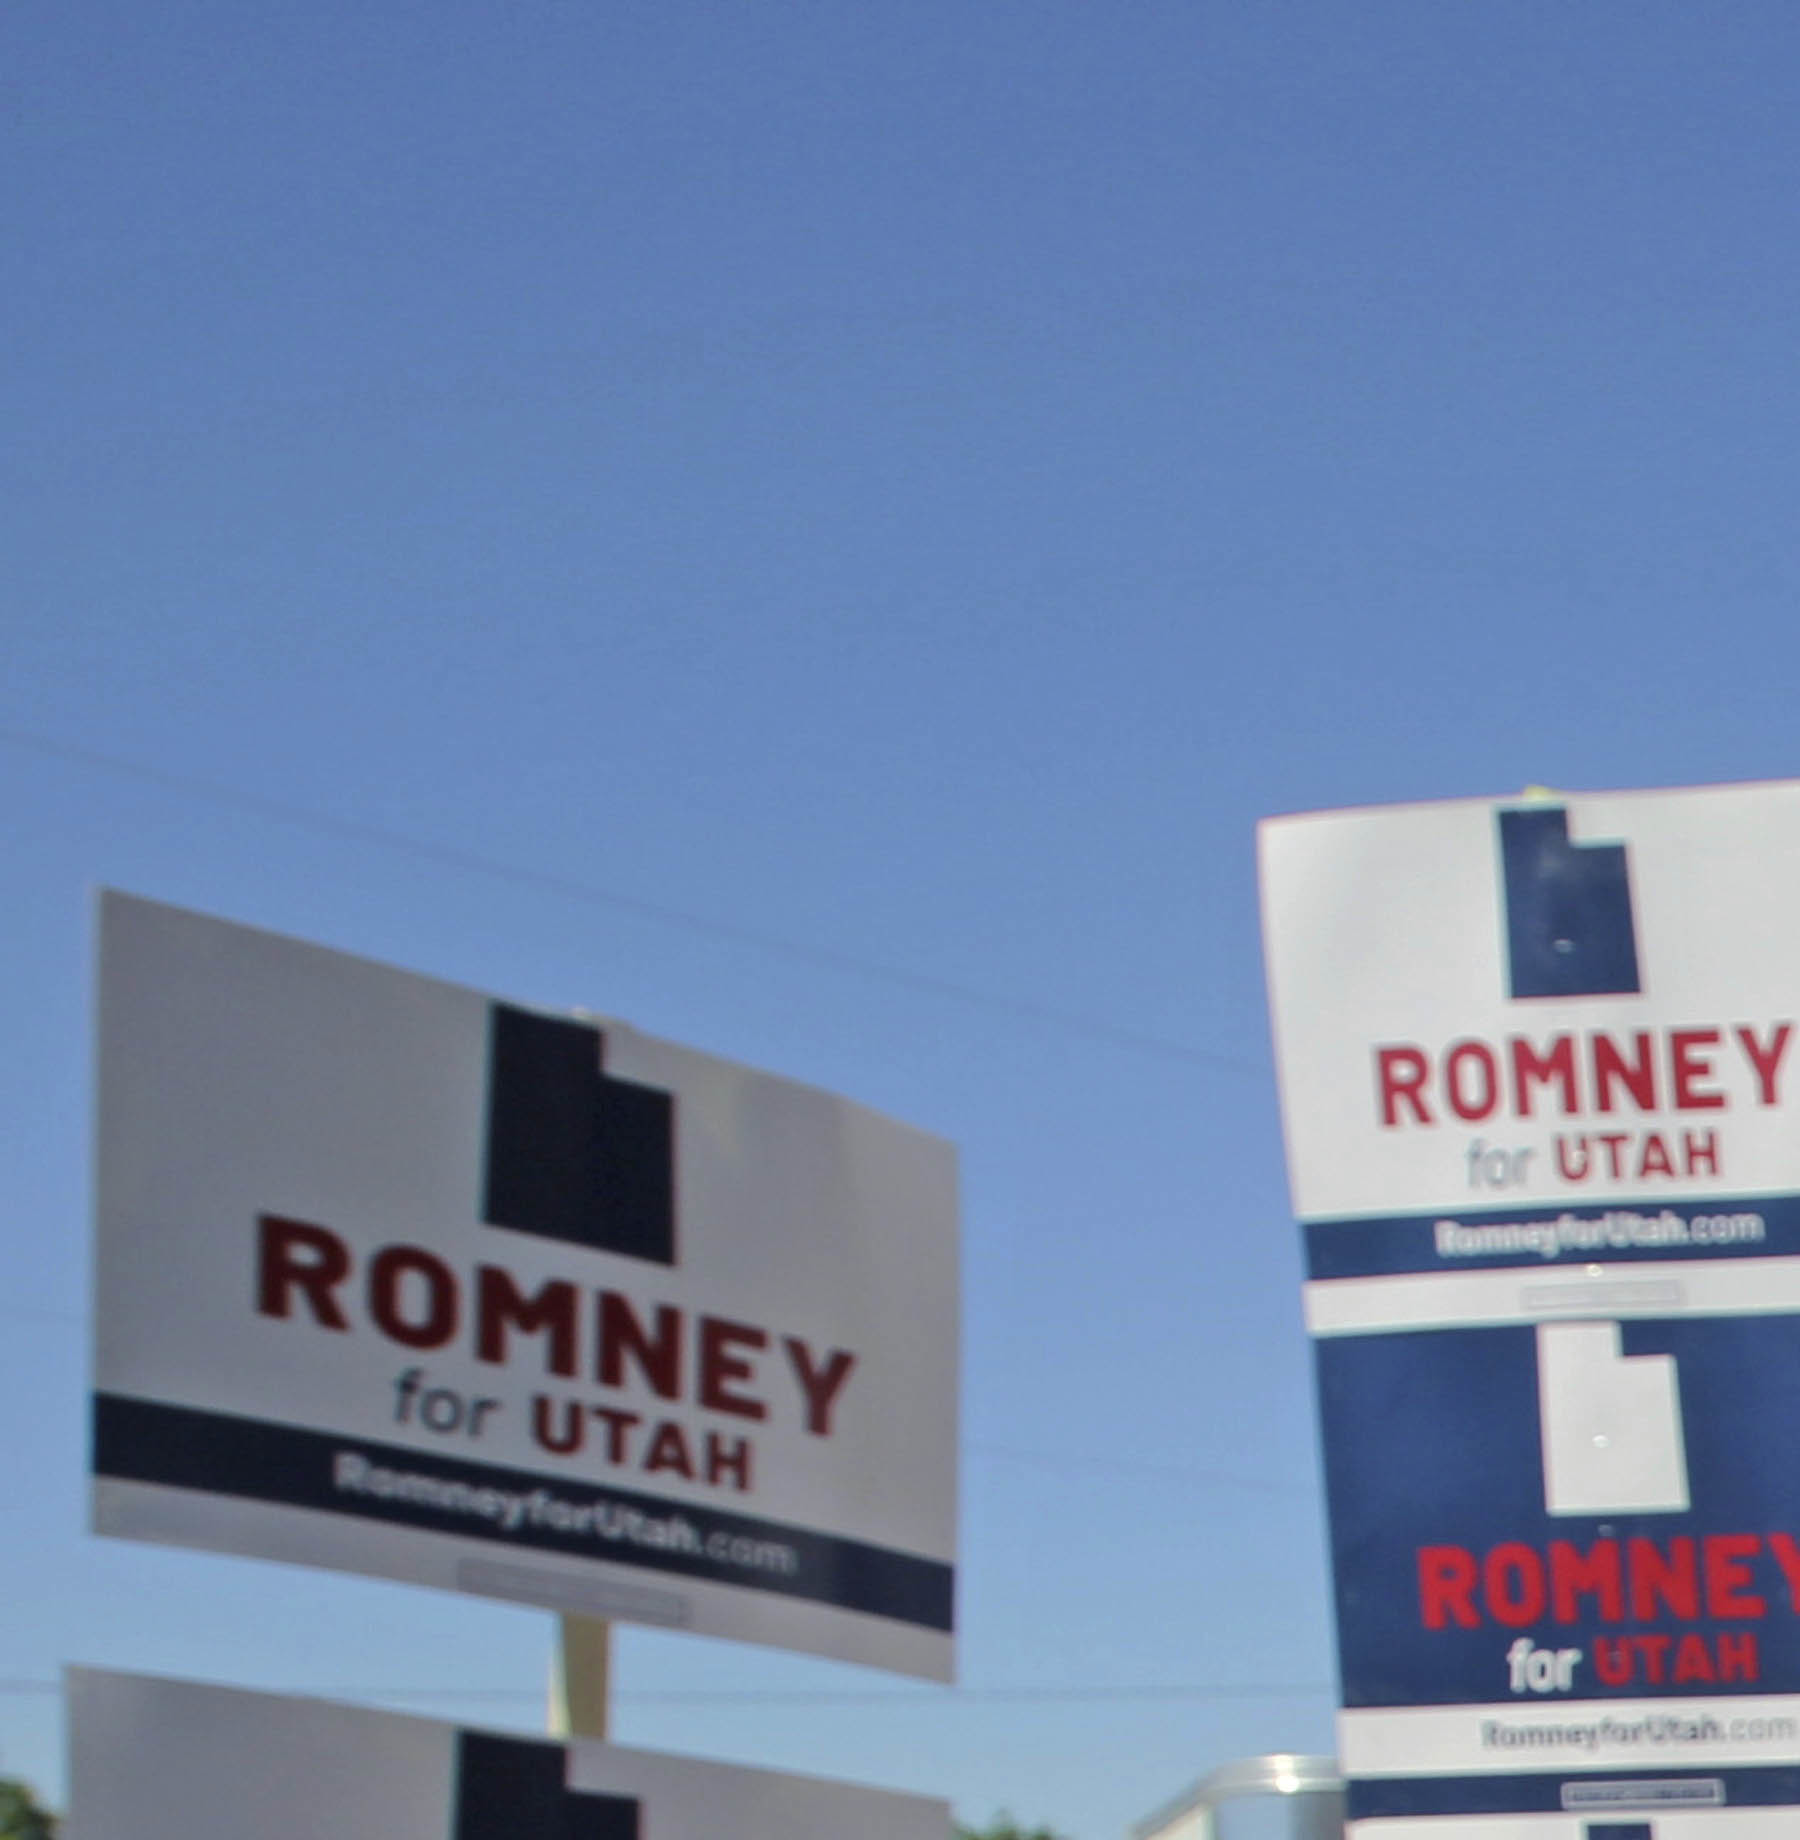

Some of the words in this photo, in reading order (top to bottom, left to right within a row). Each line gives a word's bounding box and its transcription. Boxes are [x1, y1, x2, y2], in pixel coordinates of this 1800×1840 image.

[1373, 1021, 1795, 1130] ROMNEY
[1465, 1139, 1533, 1189] for
[1553, 1129, 1720, 1184] UTAH
[1433, 1211, 1766, 1259] RomneyforUtah.com
[256, 1211, 858, 1437] ROMNEY
[392, 1367, 498, 1440] for
[531, 1393, 755, 1492] UTAH
[332, 1451, 796, 1575] RomneyforUtah.com
[1507, 1636, 1581, 1694] for
[1592, 1632, 1760, 1688] UTAH
[1479, 1715, 1798, 1750] RomneyforUtah.com
